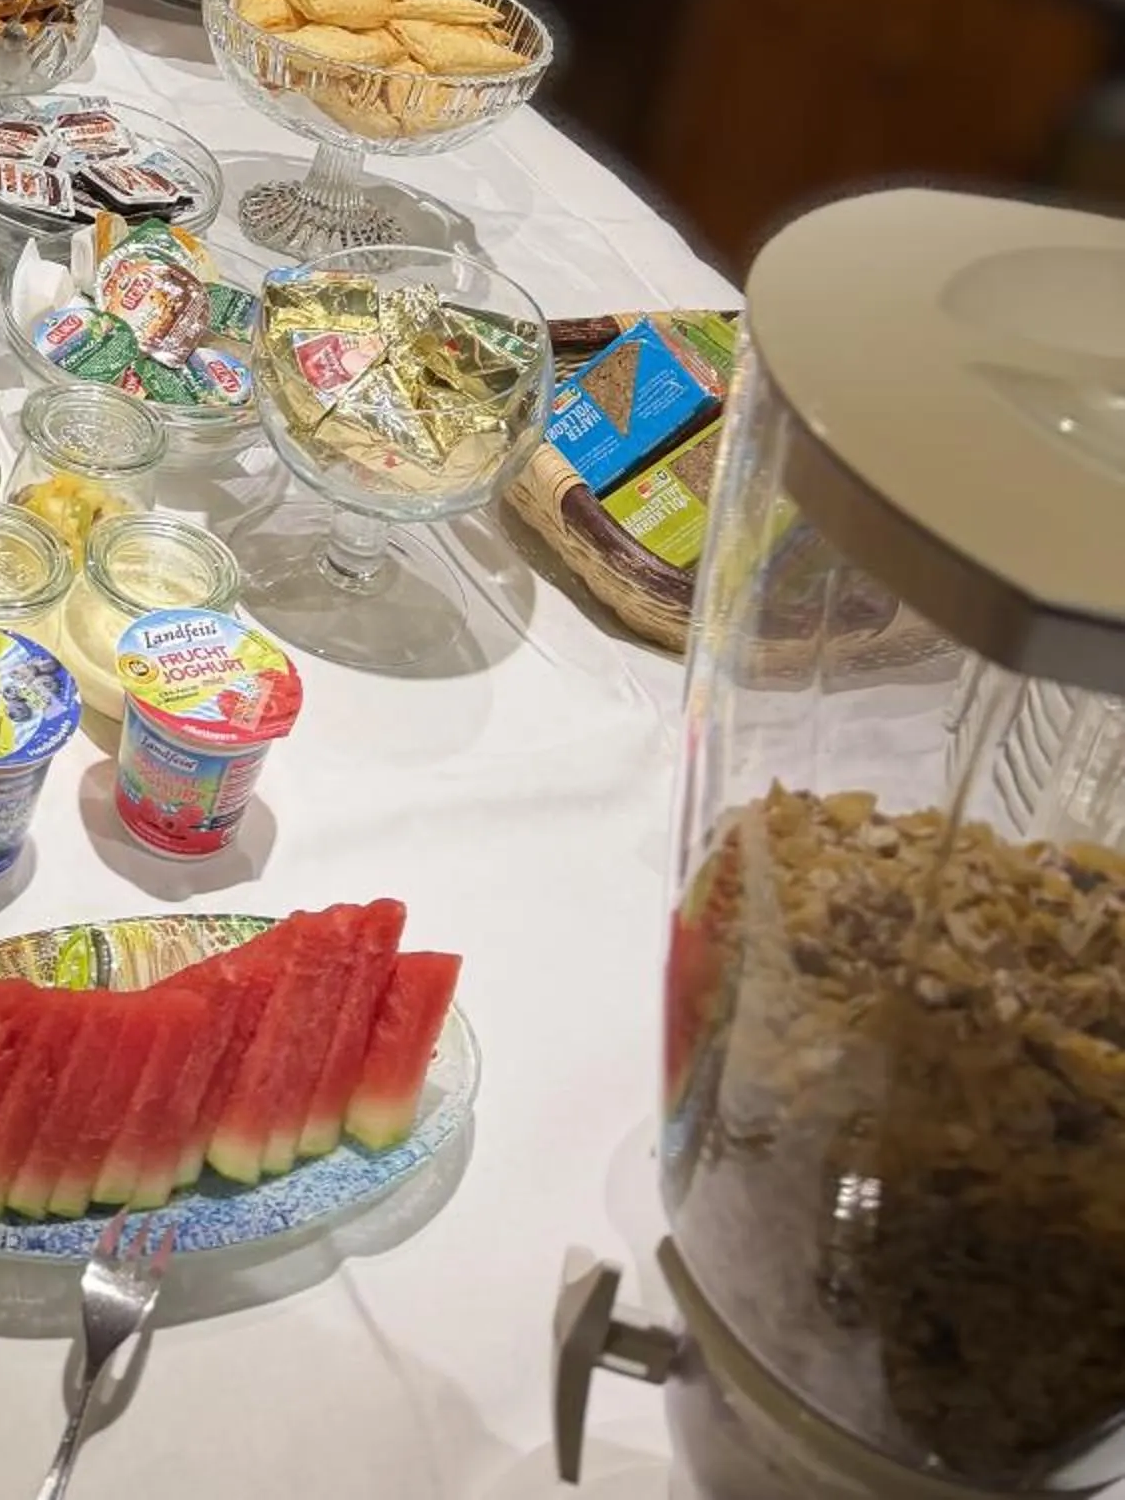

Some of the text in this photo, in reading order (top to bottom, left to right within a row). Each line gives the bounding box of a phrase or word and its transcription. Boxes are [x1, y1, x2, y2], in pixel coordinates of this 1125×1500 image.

[568, 410, 603, 442] HAFER
[144, 621, 216, 648] Landfein
[158, 646, 228, 669] FRUCHT
[162, 658, 246, 684] JOGHURT
